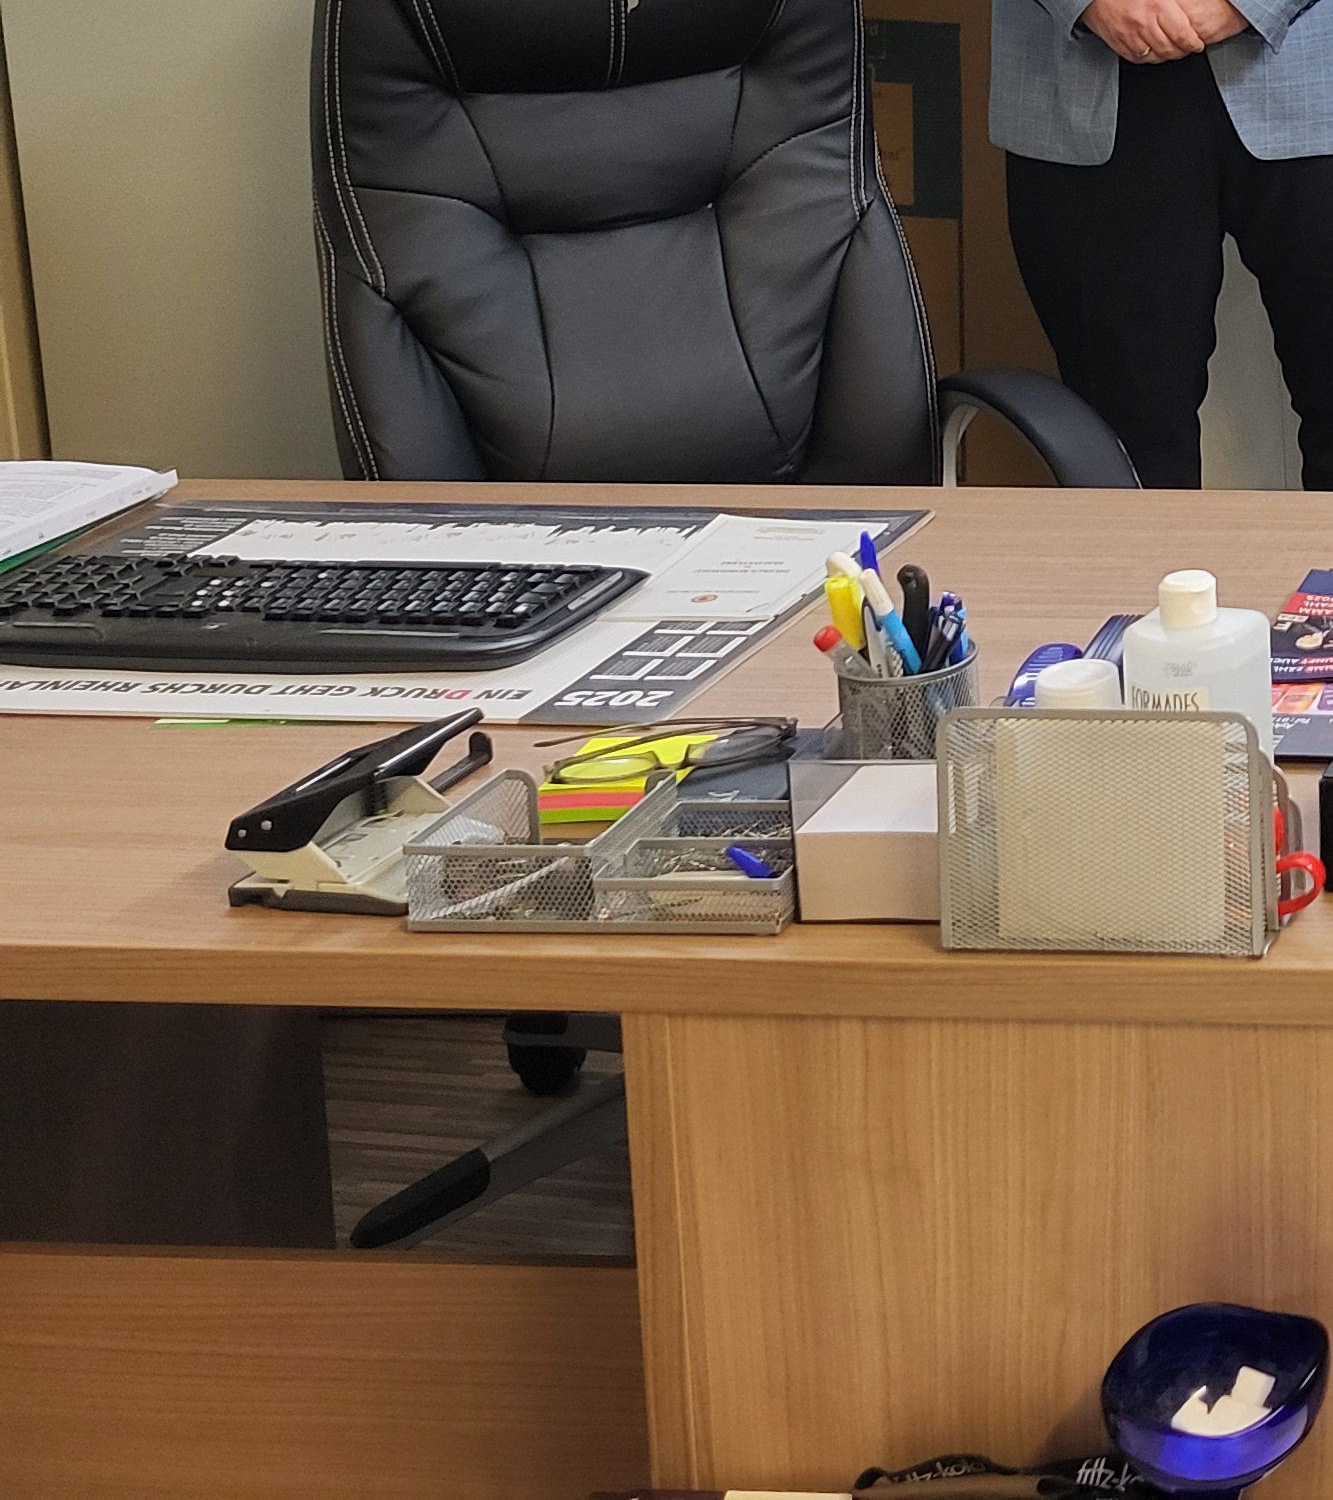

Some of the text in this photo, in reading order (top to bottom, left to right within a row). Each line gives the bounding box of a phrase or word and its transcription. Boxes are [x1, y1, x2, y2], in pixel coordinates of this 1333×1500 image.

[0, 680, 533, 701] EIN DRUCK GEHT DURCHS RHEINLA
[554, 689, 674, 707] 2025
